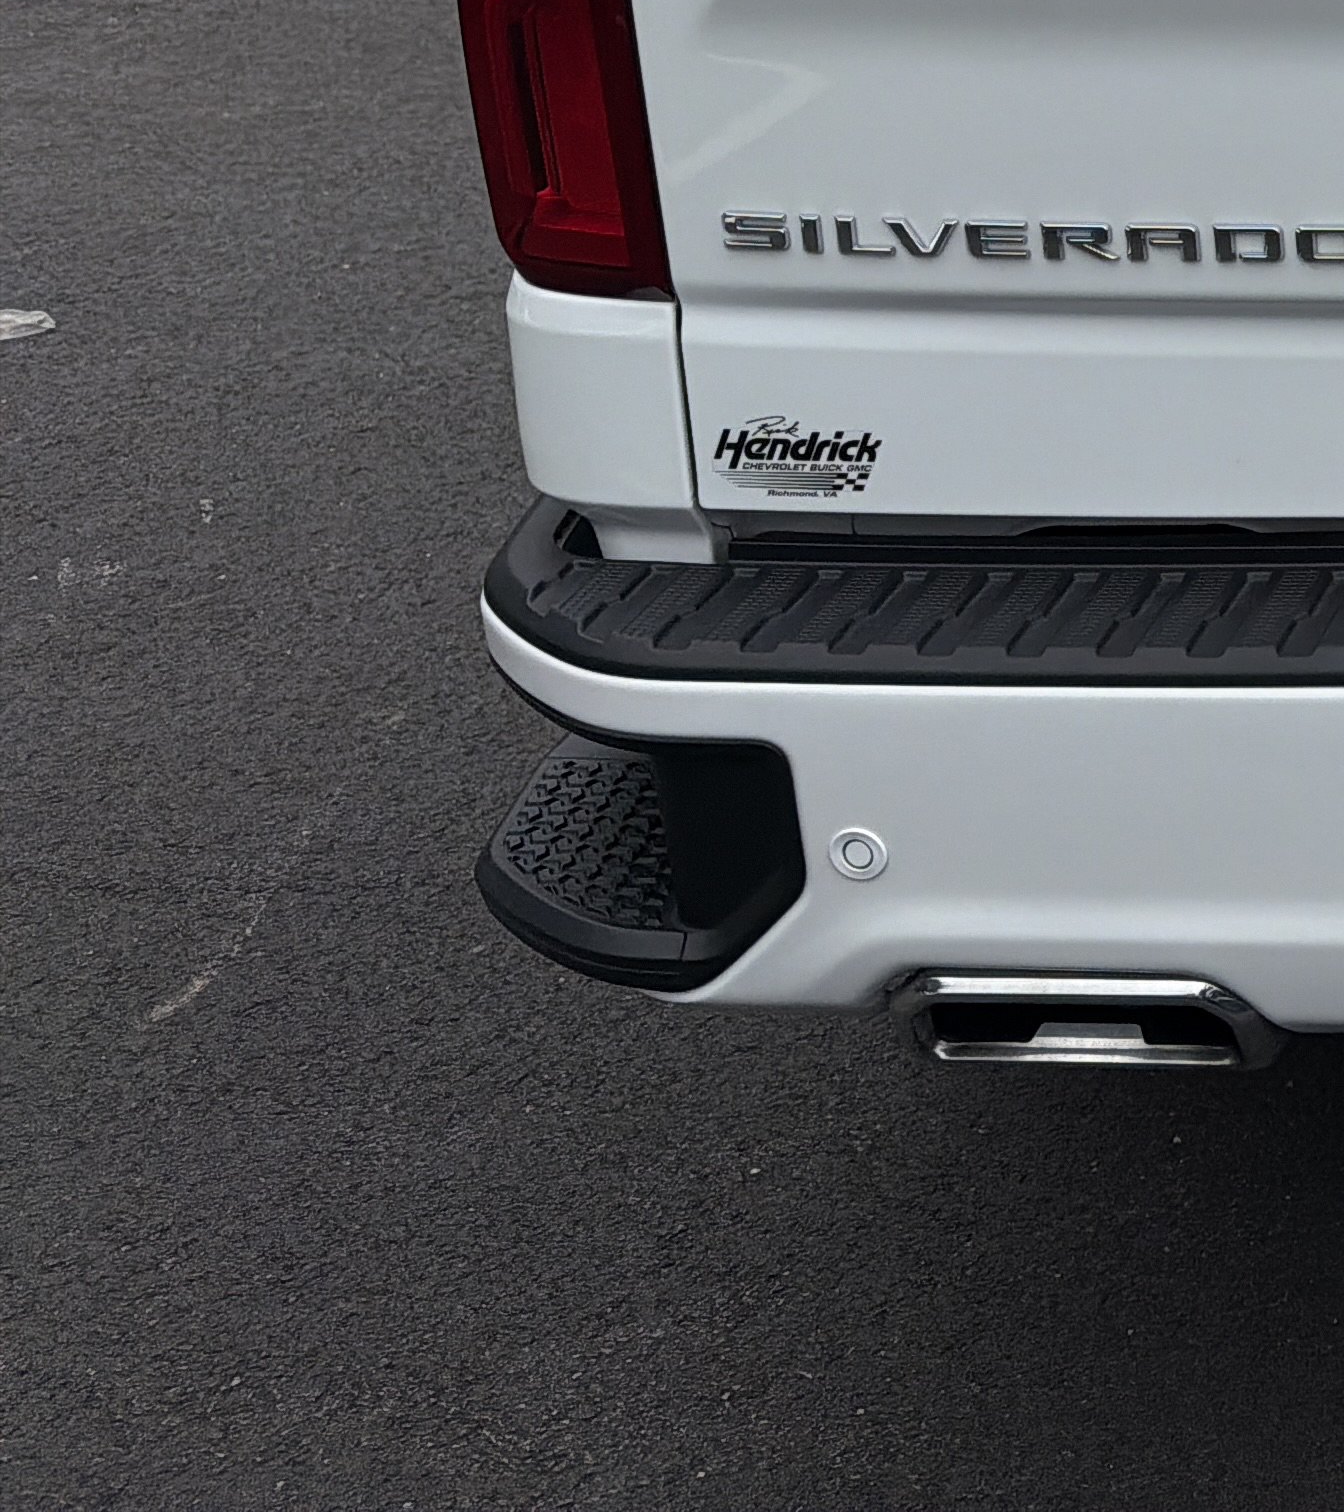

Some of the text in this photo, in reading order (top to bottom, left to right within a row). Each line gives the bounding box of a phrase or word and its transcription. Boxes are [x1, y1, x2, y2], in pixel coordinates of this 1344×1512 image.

[714, 429, 882, 469] Hendrick
[742, 462, 872, 472] CHEVROLET BUICK GMC
